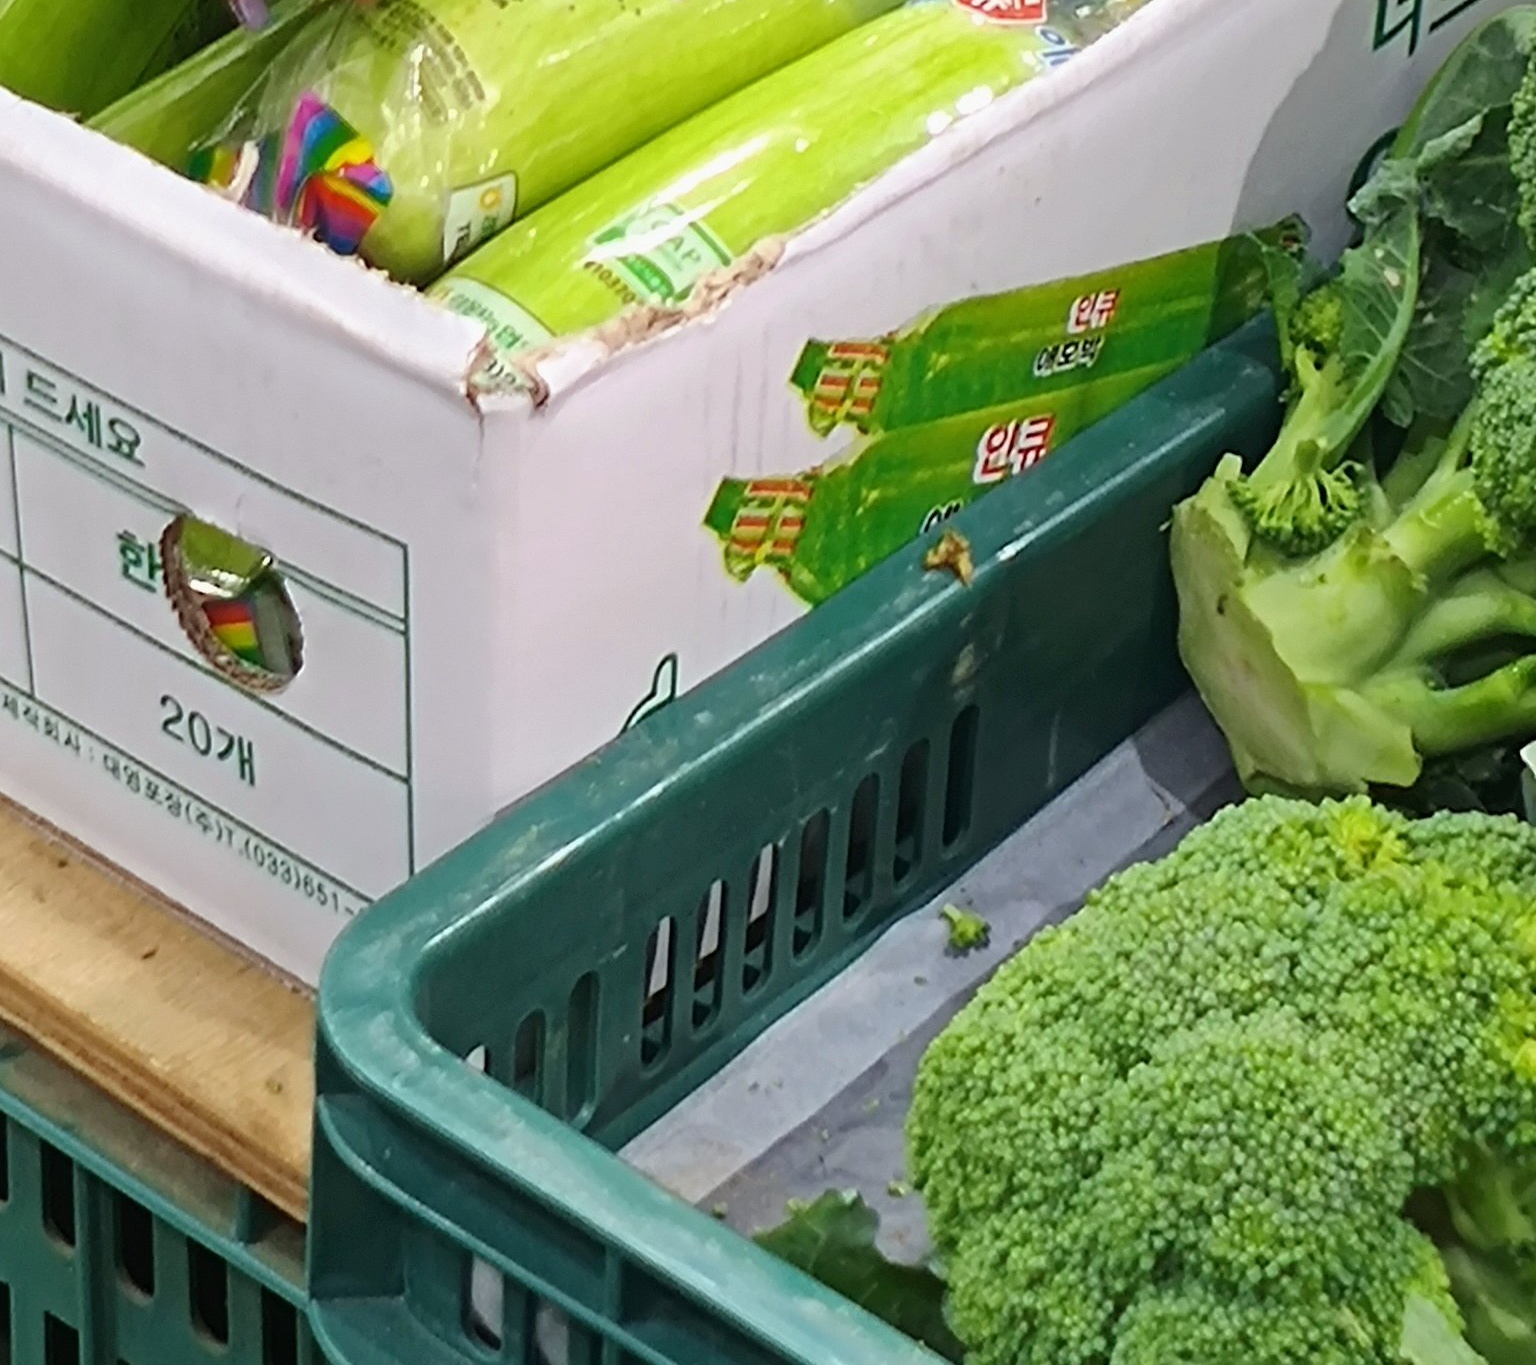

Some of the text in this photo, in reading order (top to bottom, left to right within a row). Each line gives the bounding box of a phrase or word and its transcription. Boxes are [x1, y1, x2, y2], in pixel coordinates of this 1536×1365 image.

[22, 369, 147, 470] 드세요
[0, 691, 83, 756] 제작회사
[159, 693, 257, 788] 20개
